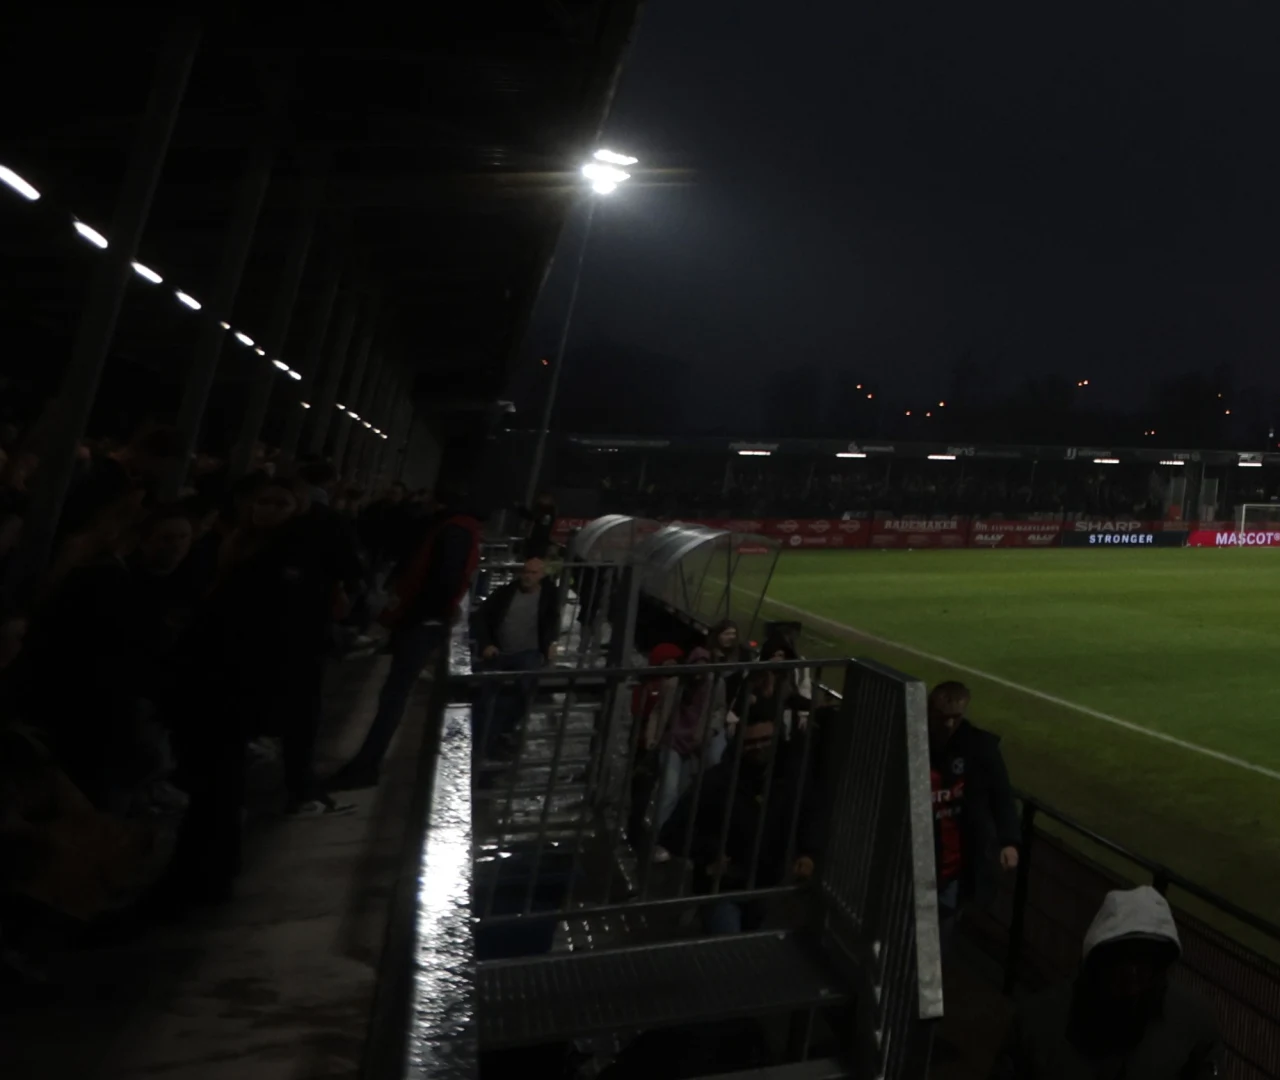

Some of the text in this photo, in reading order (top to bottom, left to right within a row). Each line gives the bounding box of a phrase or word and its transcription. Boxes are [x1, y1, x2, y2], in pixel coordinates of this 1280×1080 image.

[884, 520, 957, 530] RADEMAKER
[1075, 521, 1142, 532] SHARP
[1089, 534, 1154, 544] STRONGER
